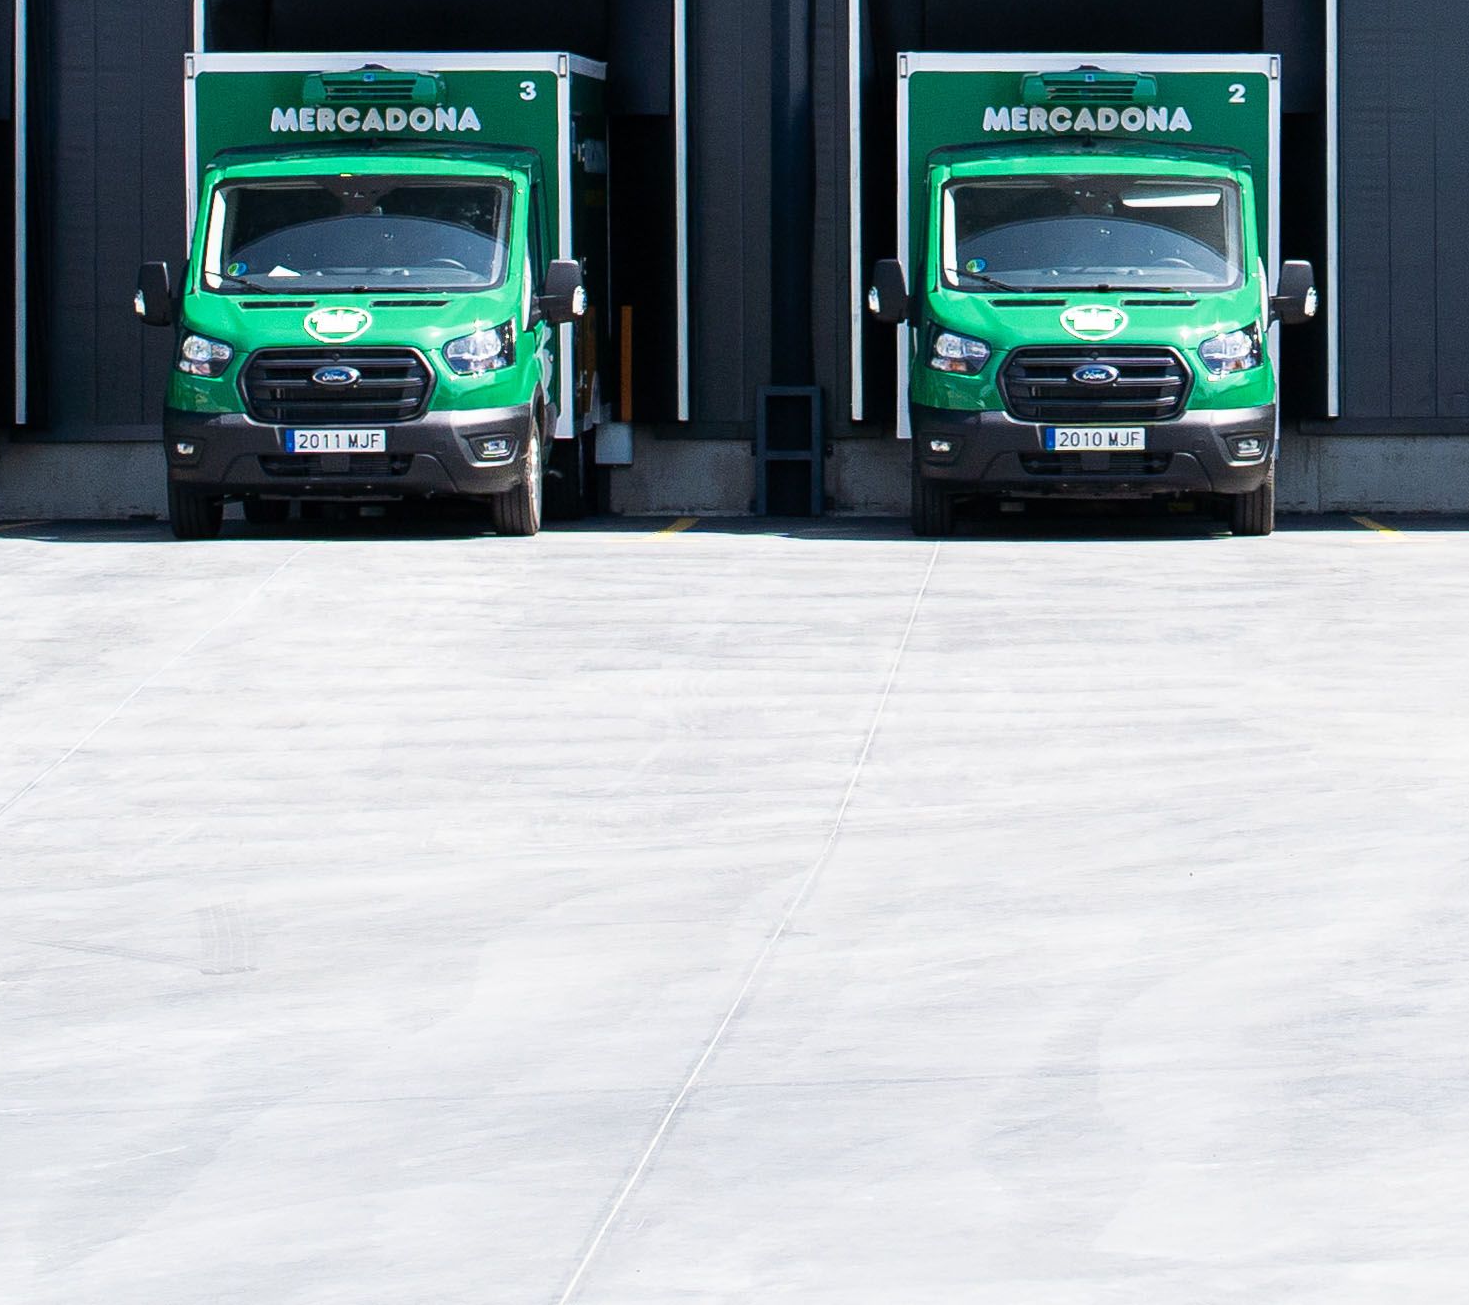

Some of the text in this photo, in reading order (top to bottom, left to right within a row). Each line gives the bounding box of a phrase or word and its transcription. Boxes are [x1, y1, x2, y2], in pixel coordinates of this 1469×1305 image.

[519, 81, 537, 101] 3
[1228, 83, 1246, 103] 2
[270, 107, 481, 132] MERCADONA
[982, 106, 1192, 132] MERCADONA
[299, 433, 380, 449] 2011 MJF
[1059, 431, 1140, 447] 2010 MJF
